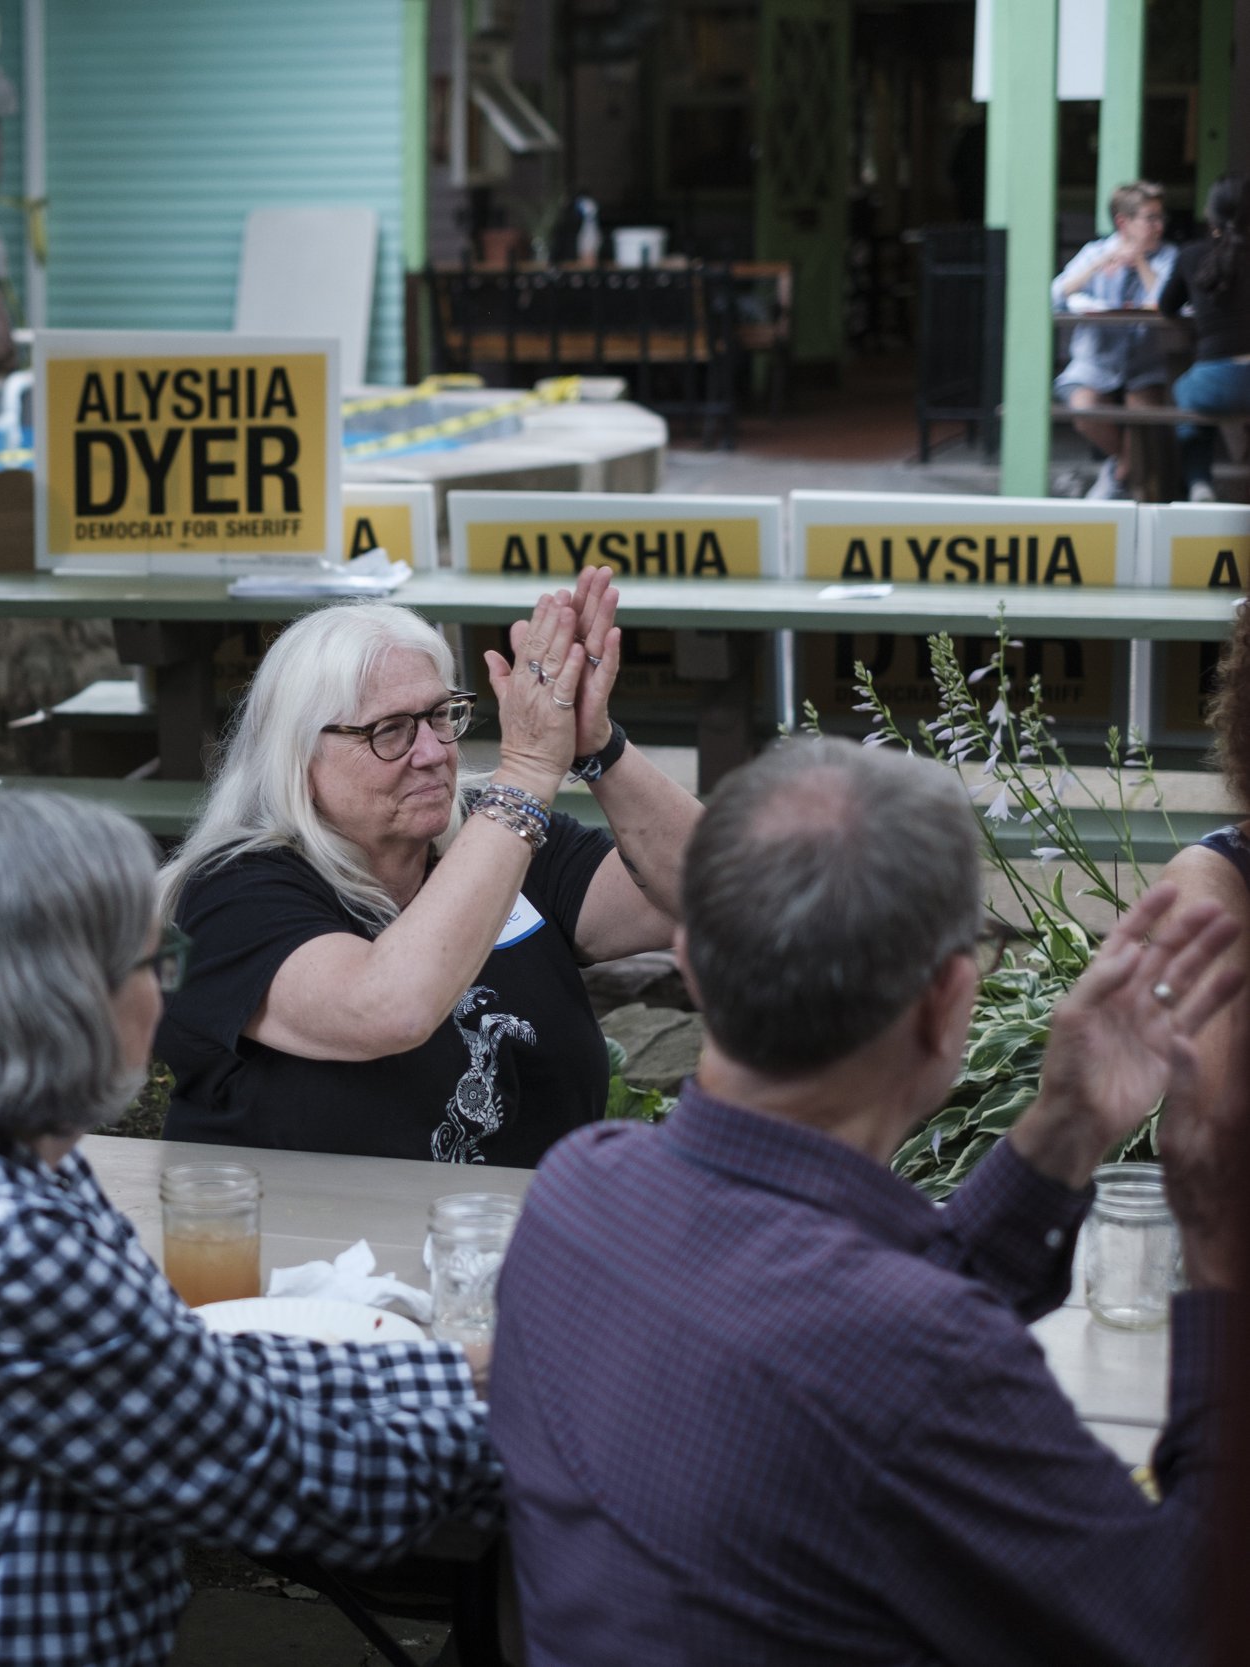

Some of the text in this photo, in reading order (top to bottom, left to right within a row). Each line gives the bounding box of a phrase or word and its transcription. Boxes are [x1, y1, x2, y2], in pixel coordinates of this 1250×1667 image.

[76, 367, 298, 423] ALYSHIA
[74, 426, 303, 517] DYER
[75, 518, 302, 541] DEMOCRAT FOR SHERIFF
[501, 529, 729, 577] ALYSHIA
[840, 535, 1083, 585] ALYSHIA
